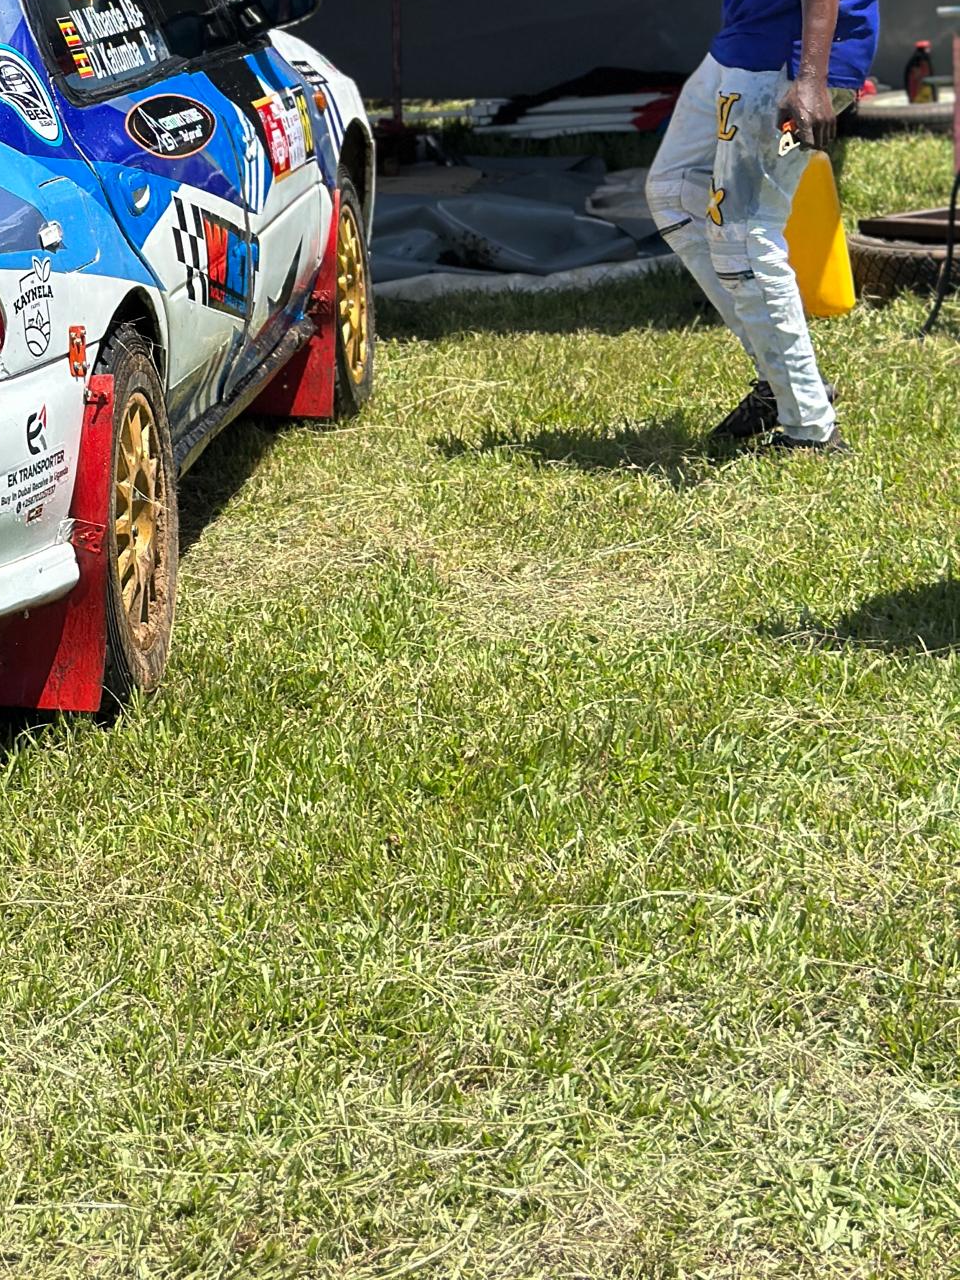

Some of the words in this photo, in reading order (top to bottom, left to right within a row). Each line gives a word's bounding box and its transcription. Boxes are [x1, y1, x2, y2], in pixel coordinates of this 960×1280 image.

[13, 285, 54, 316] KAYNELA
[7, 471, 18, 488] EK
[19, 450, 65, 483] TRANSPORTER
